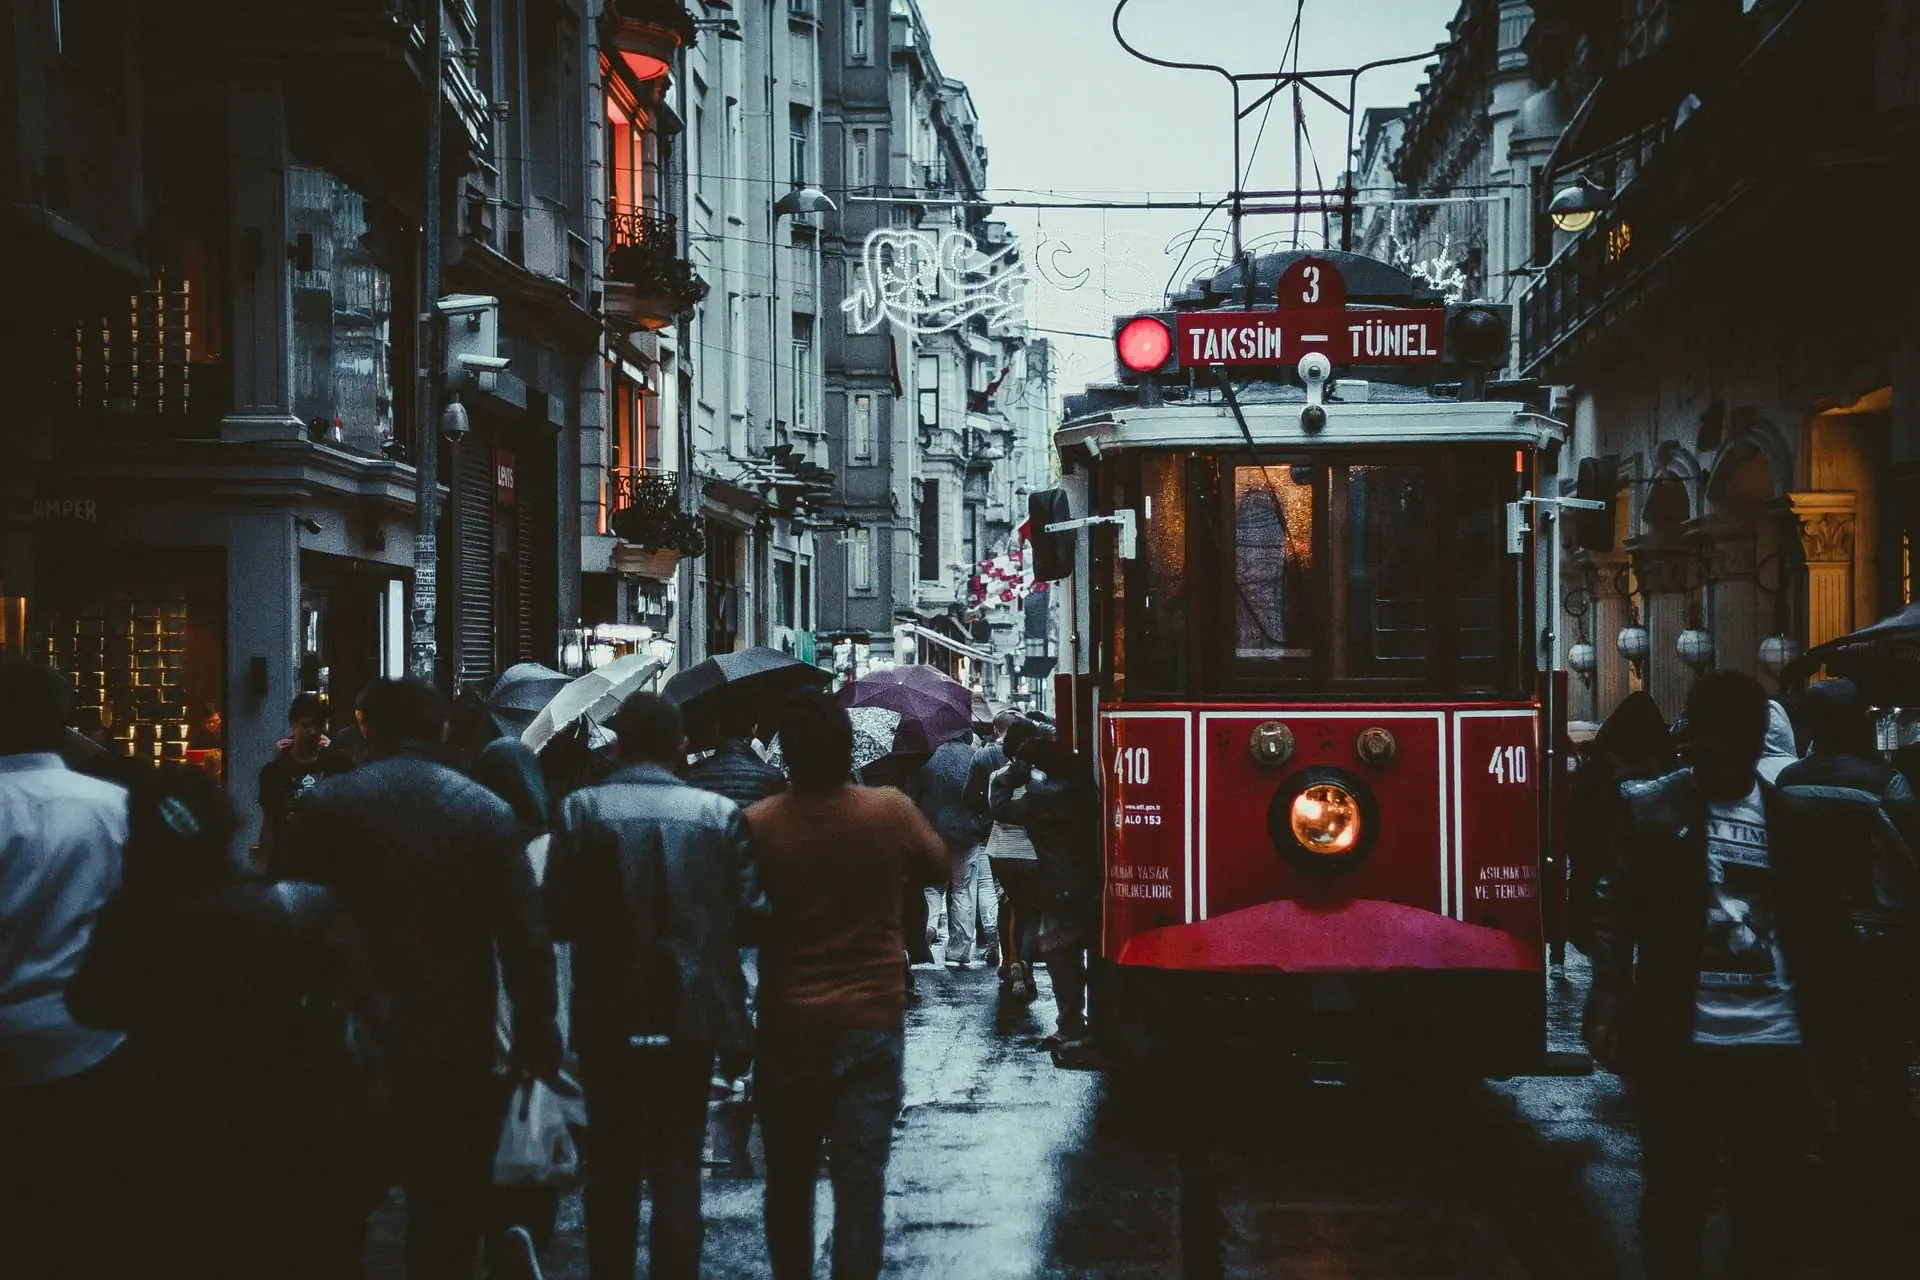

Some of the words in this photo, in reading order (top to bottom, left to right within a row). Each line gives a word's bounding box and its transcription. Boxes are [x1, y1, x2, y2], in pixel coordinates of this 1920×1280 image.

[1302, 265, 1320, 303] 3
[1188, 320, 1282, 360] TAKSİM
[1348, 319, 1437, 357] TÜNEL
[1114, 747, 1149, 784] 410
[1488, 745, 1526, 784] 410
[1124, 815, 1141, 825] ALO
[1143, 815, 1161, 825] 153
